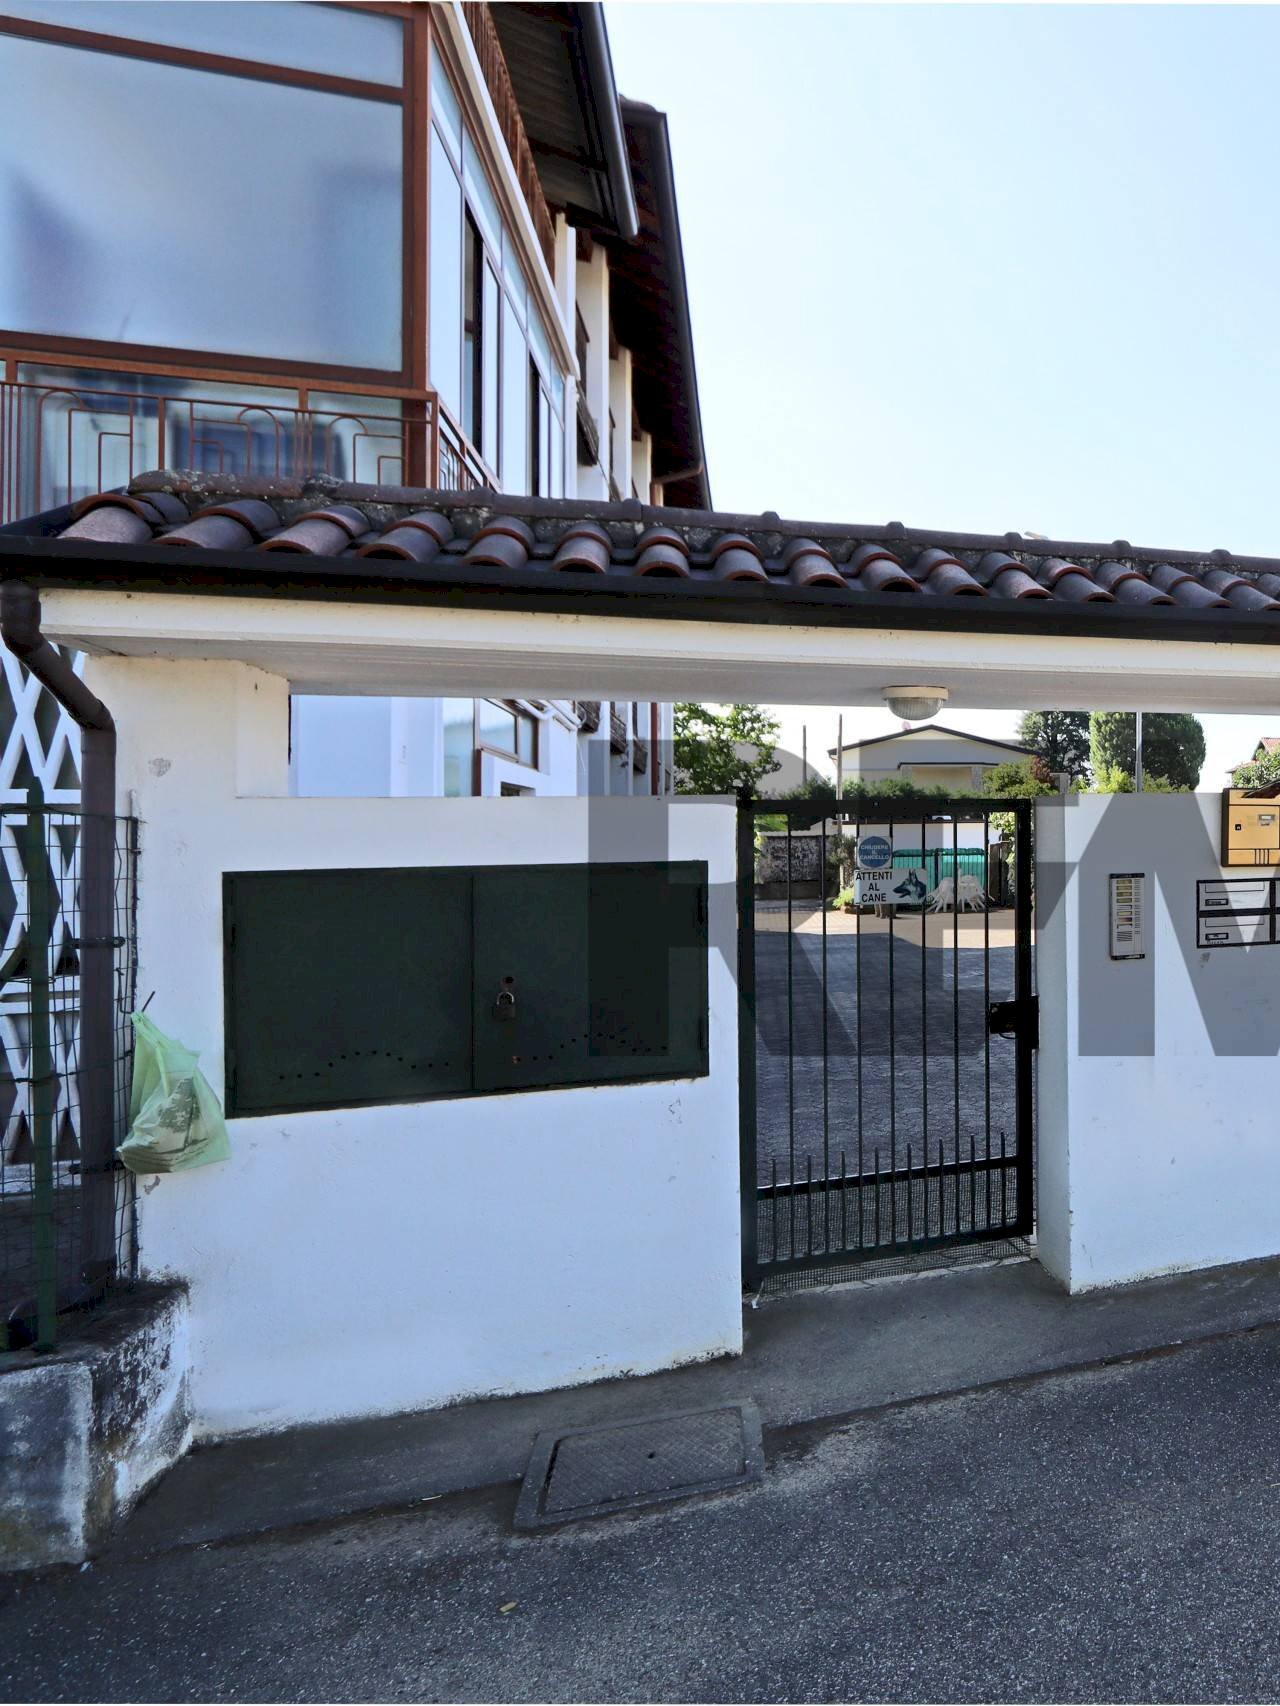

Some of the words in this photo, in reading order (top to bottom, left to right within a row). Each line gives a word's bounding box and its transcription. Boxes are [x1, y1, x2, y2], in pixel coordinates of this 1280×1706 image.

[856, 871, 892, 881] ATTENTI
[868, 883, 880, 892] AL
[861, 893, 887, 903] CANE
